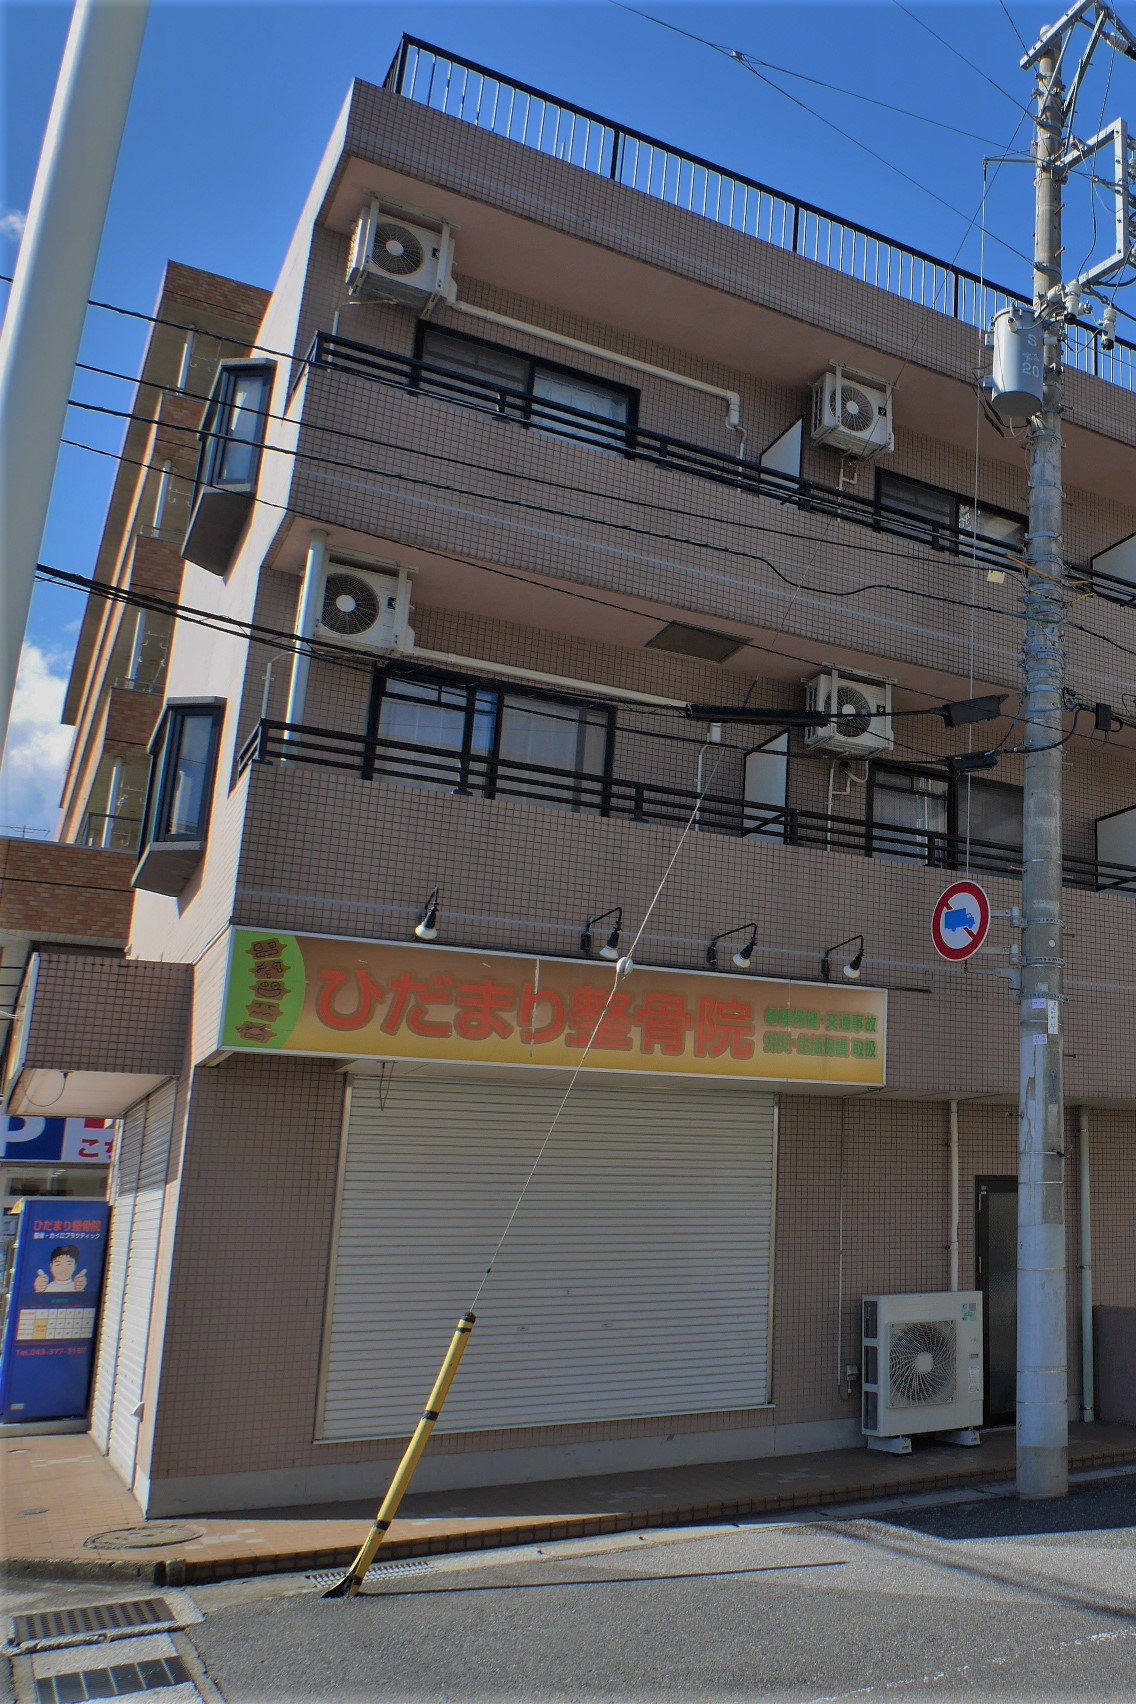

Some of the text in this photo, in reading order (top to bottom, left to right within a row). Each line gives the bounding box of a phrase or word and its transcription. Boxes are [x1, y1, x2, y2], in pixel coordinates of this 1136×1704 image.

[1022, 362, 1040, 378] 20
[318, 969, 754, 1058] ひだまり整骨院
